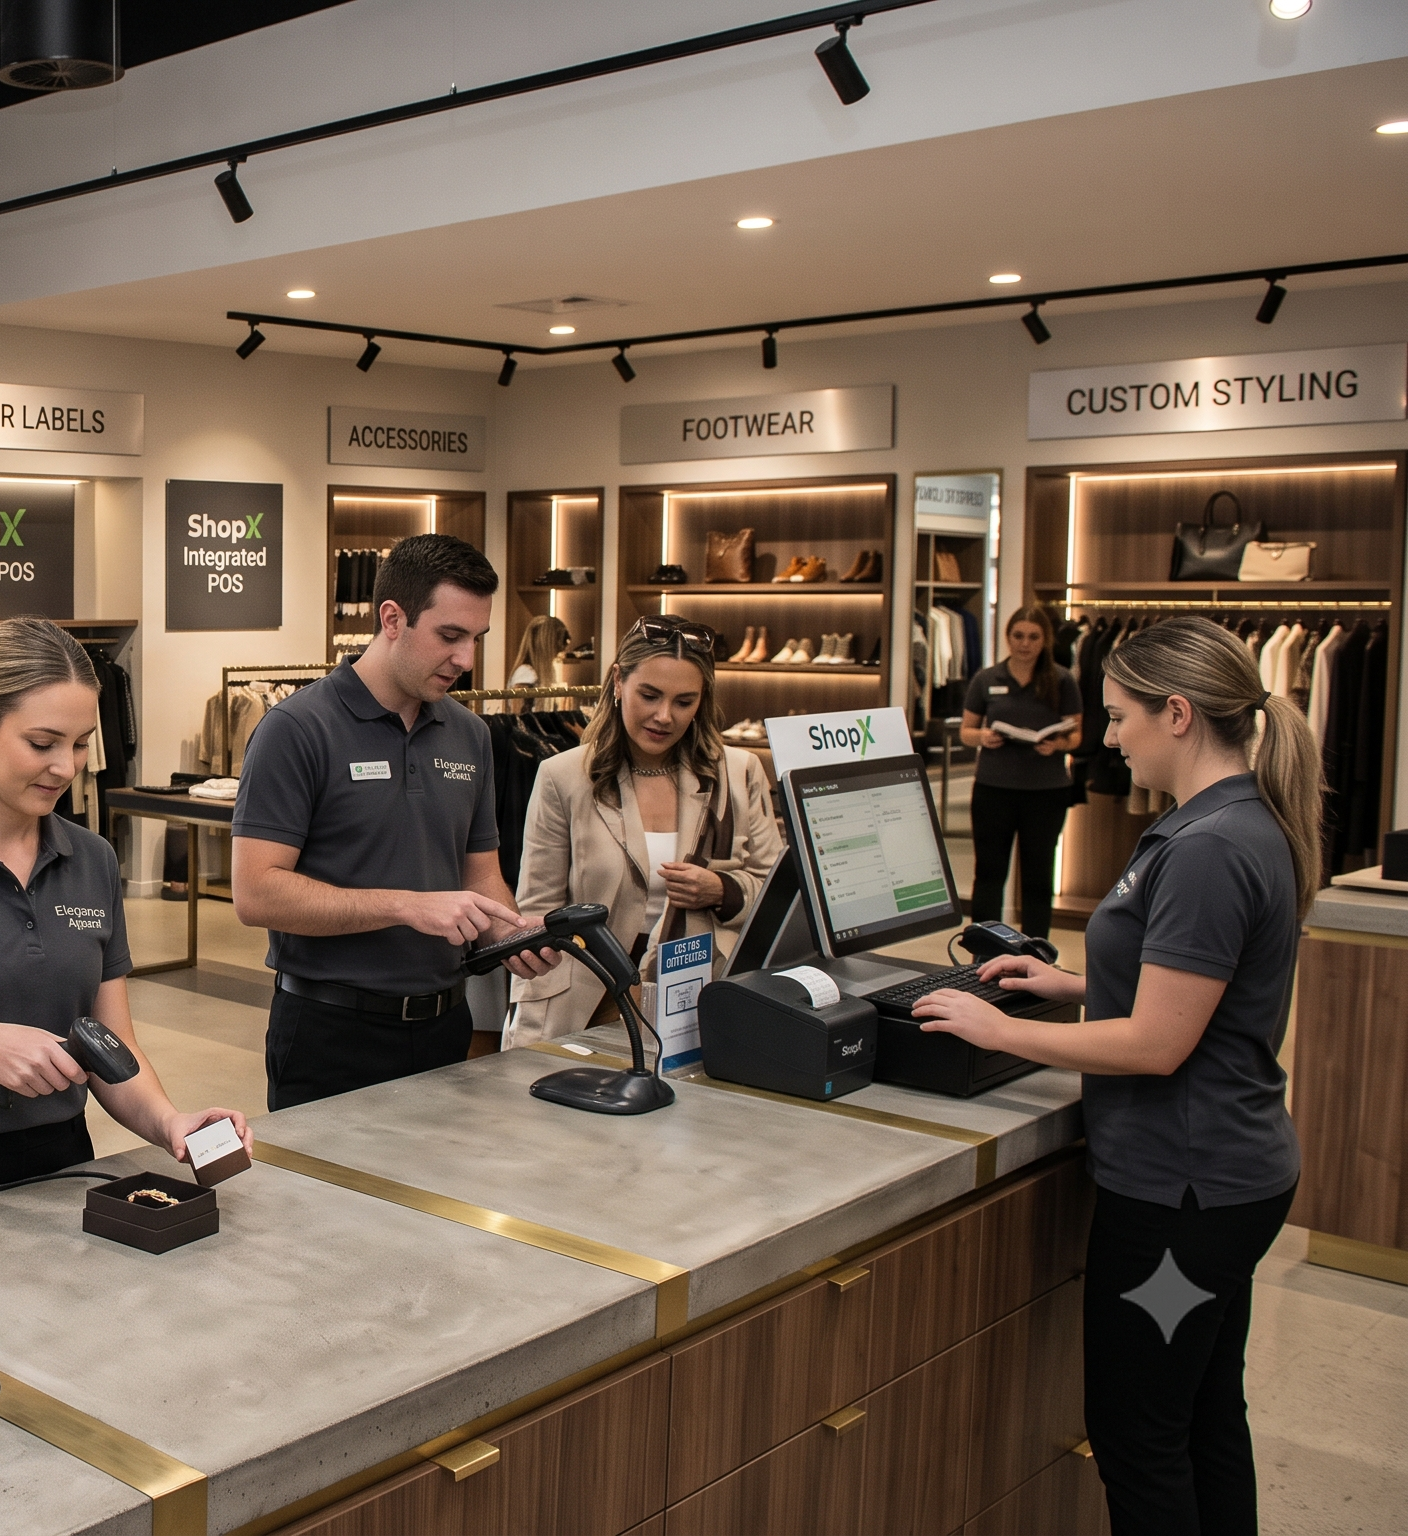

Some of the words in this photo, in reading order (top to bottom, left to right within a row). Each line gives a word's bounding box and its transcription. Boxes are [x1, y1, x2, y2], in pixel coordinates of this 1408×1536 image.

[1067, 381, 1201, 416] CUSTOM
[1213, 369, 1359, 408] STYLING
[22, 402, 105, 434] LABELS
[682, 410, 814, 442] FOOTWEAR
[348, 424, 468, 455] ACCESSORIES
[187, 512, 264, 543] ShopX
[183, 546, 267, 571] Integrated
[207, 573, 244, 594] POS
[808, 715, 876, 760] ShopX
